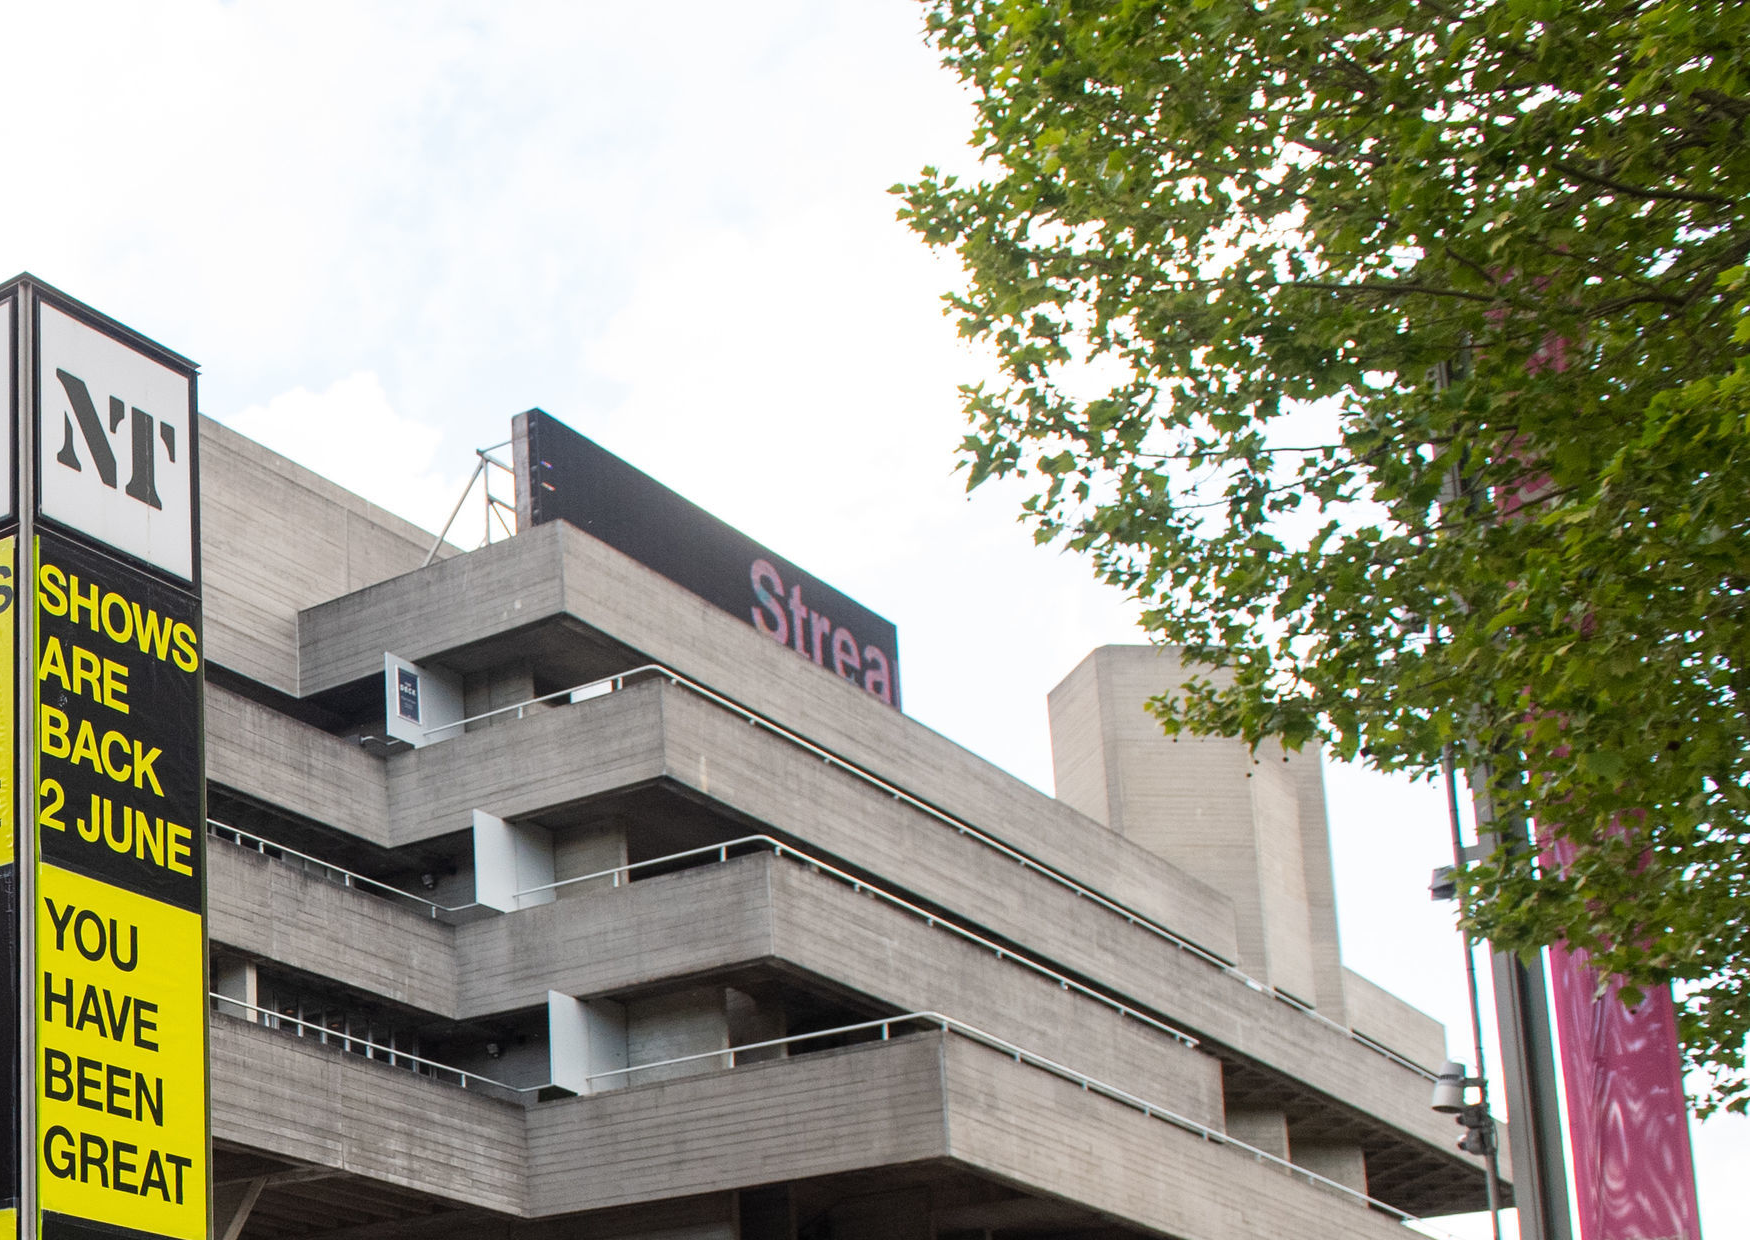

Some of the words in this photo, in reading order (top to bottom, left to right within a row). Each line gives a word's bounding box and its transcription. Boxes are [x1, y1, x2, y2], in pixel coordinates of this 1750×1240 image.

[56, 369, 176, 510] NT
[39, 564, 199, 673] SHOWS
[39, 636, 130, 714] ARE
[41, 706, 166, 797] BACK
[40, 778, 67, 833] 2
[77, 797, 194, 877] JUNE
[44, 897, 139, 972] YOU
[44, 972, 159, 1052] HAVE
[45, 1047, 164, 1128] BEEN
[44, 1125, 192, 1205] GREAT
